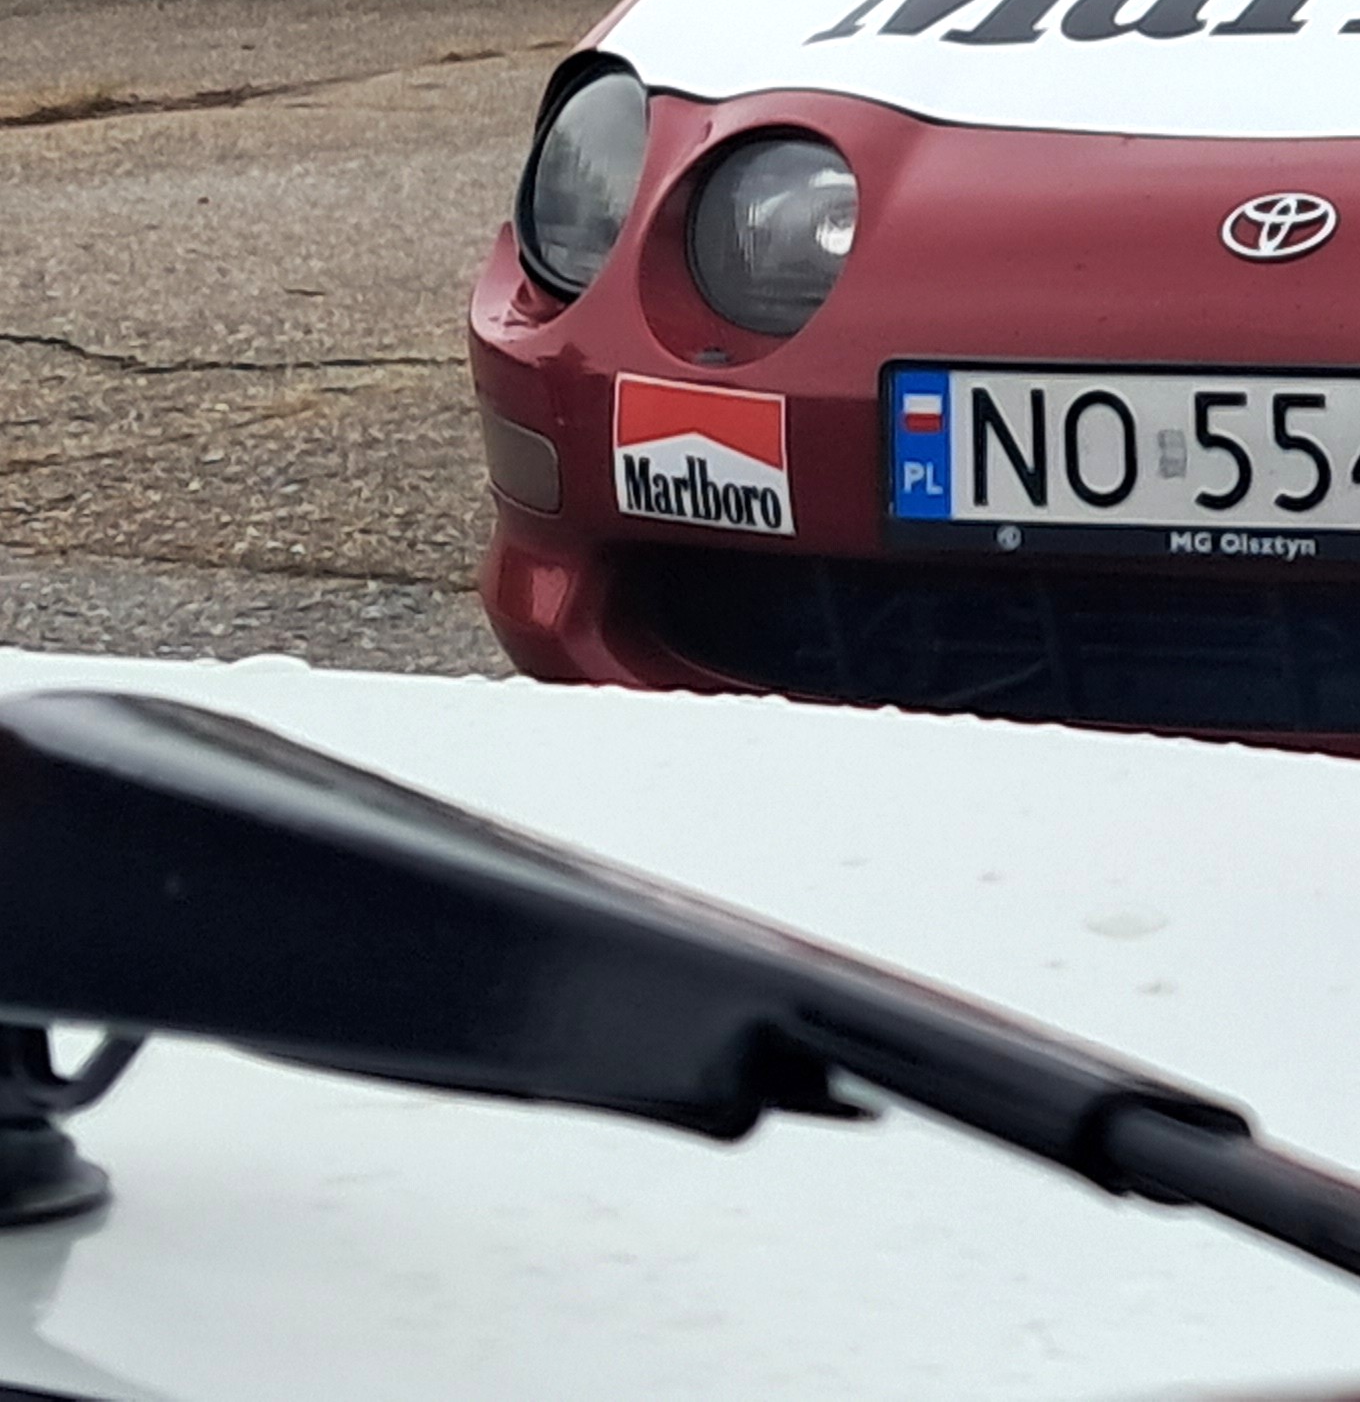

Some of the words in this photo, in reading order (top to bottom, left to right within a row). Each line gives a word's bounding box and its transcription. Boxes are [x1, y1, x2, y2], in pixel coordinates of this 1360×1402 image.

[971, 387, 1138, 509] NO
[622, 453, 783, 529] Marlboro
[903, 461, 944, 495] PL
[1169, 530, 1213, 554] MG
[1219, 531, 1317, 563] Olsztyn
